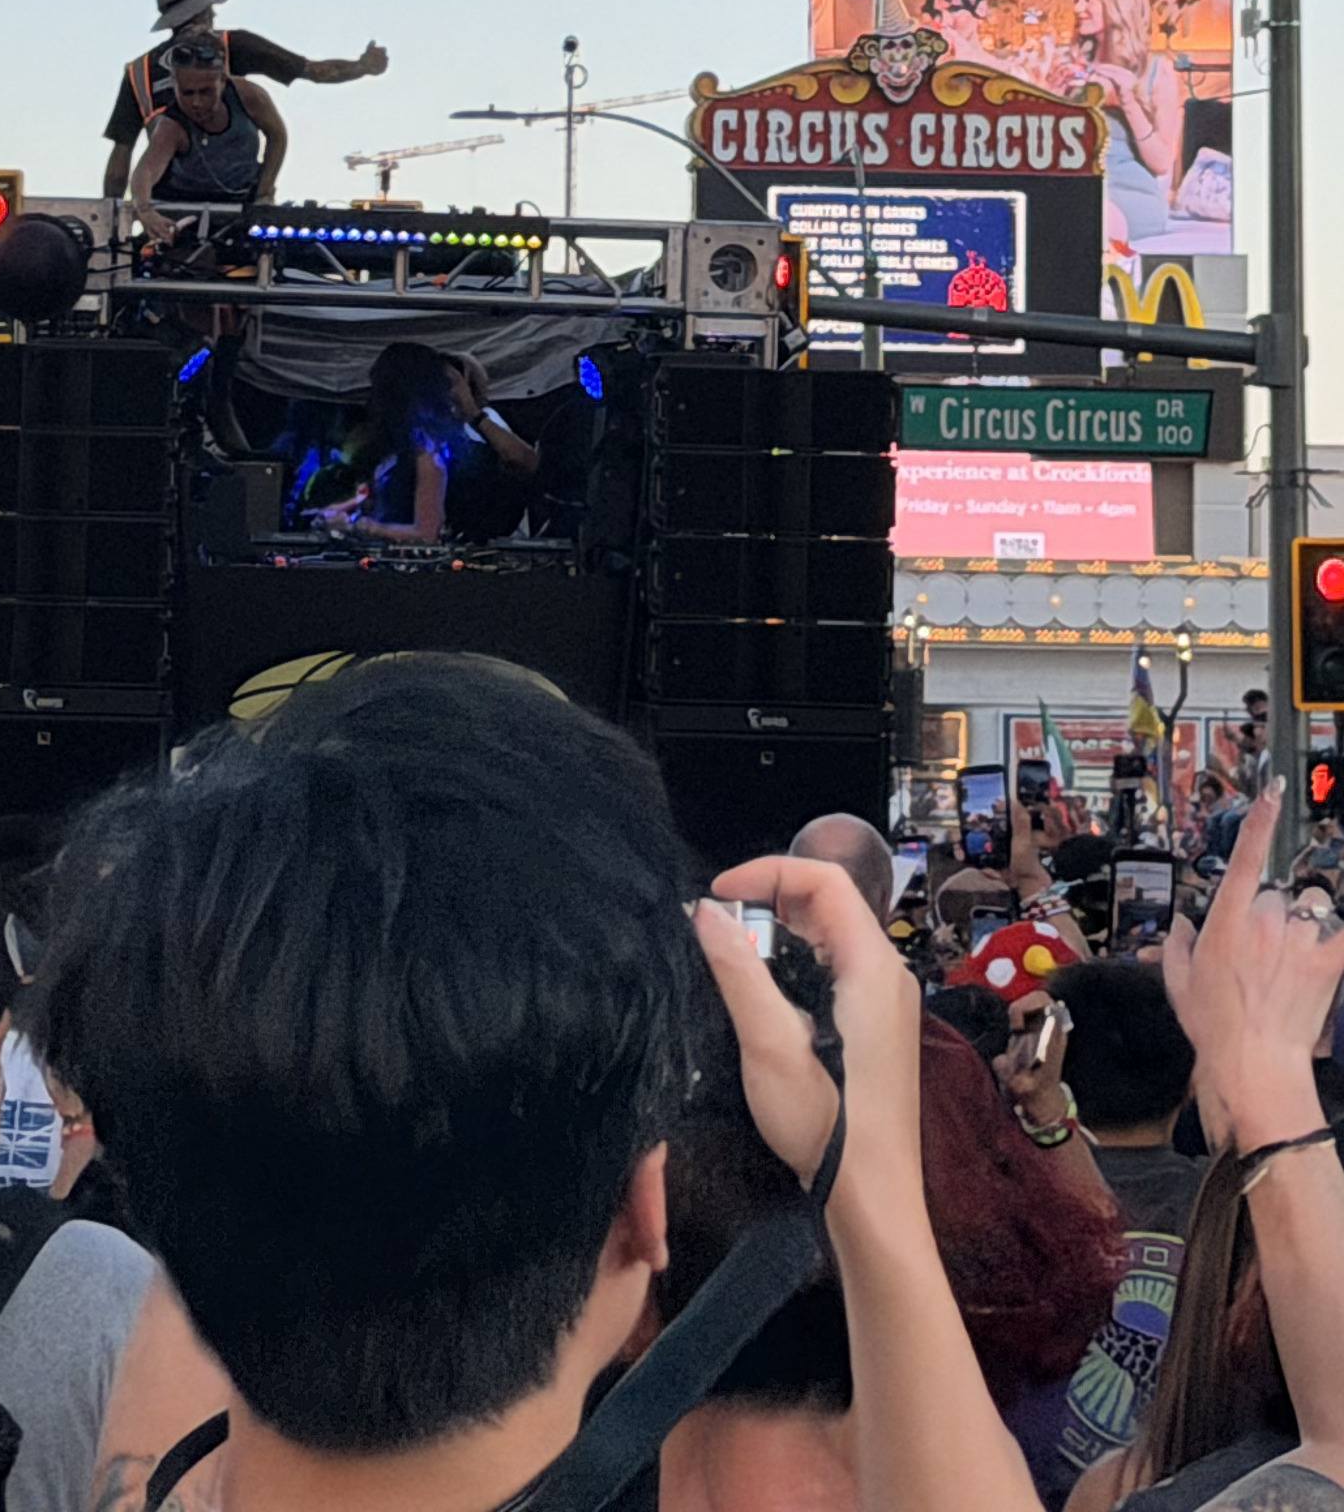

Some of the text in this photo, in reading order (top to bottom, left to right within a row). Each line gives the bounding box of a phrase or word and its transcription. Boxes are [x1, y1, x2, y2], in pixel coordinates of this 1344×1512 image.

[712, 108, 1086, 170] CIRCUS CIRCUS
[820, 237, 864, 251] DOLLA
[820, 254, 864, 268] DOLLA
[909, 395, 1185, 443] W Circus Circus DR
[1157, 425, 1194, 446] 100
[896, 460, 1002, 484] xperience
[1007, 463, 1030, 482] at
[965, 499, 1027, 517] Sunday
